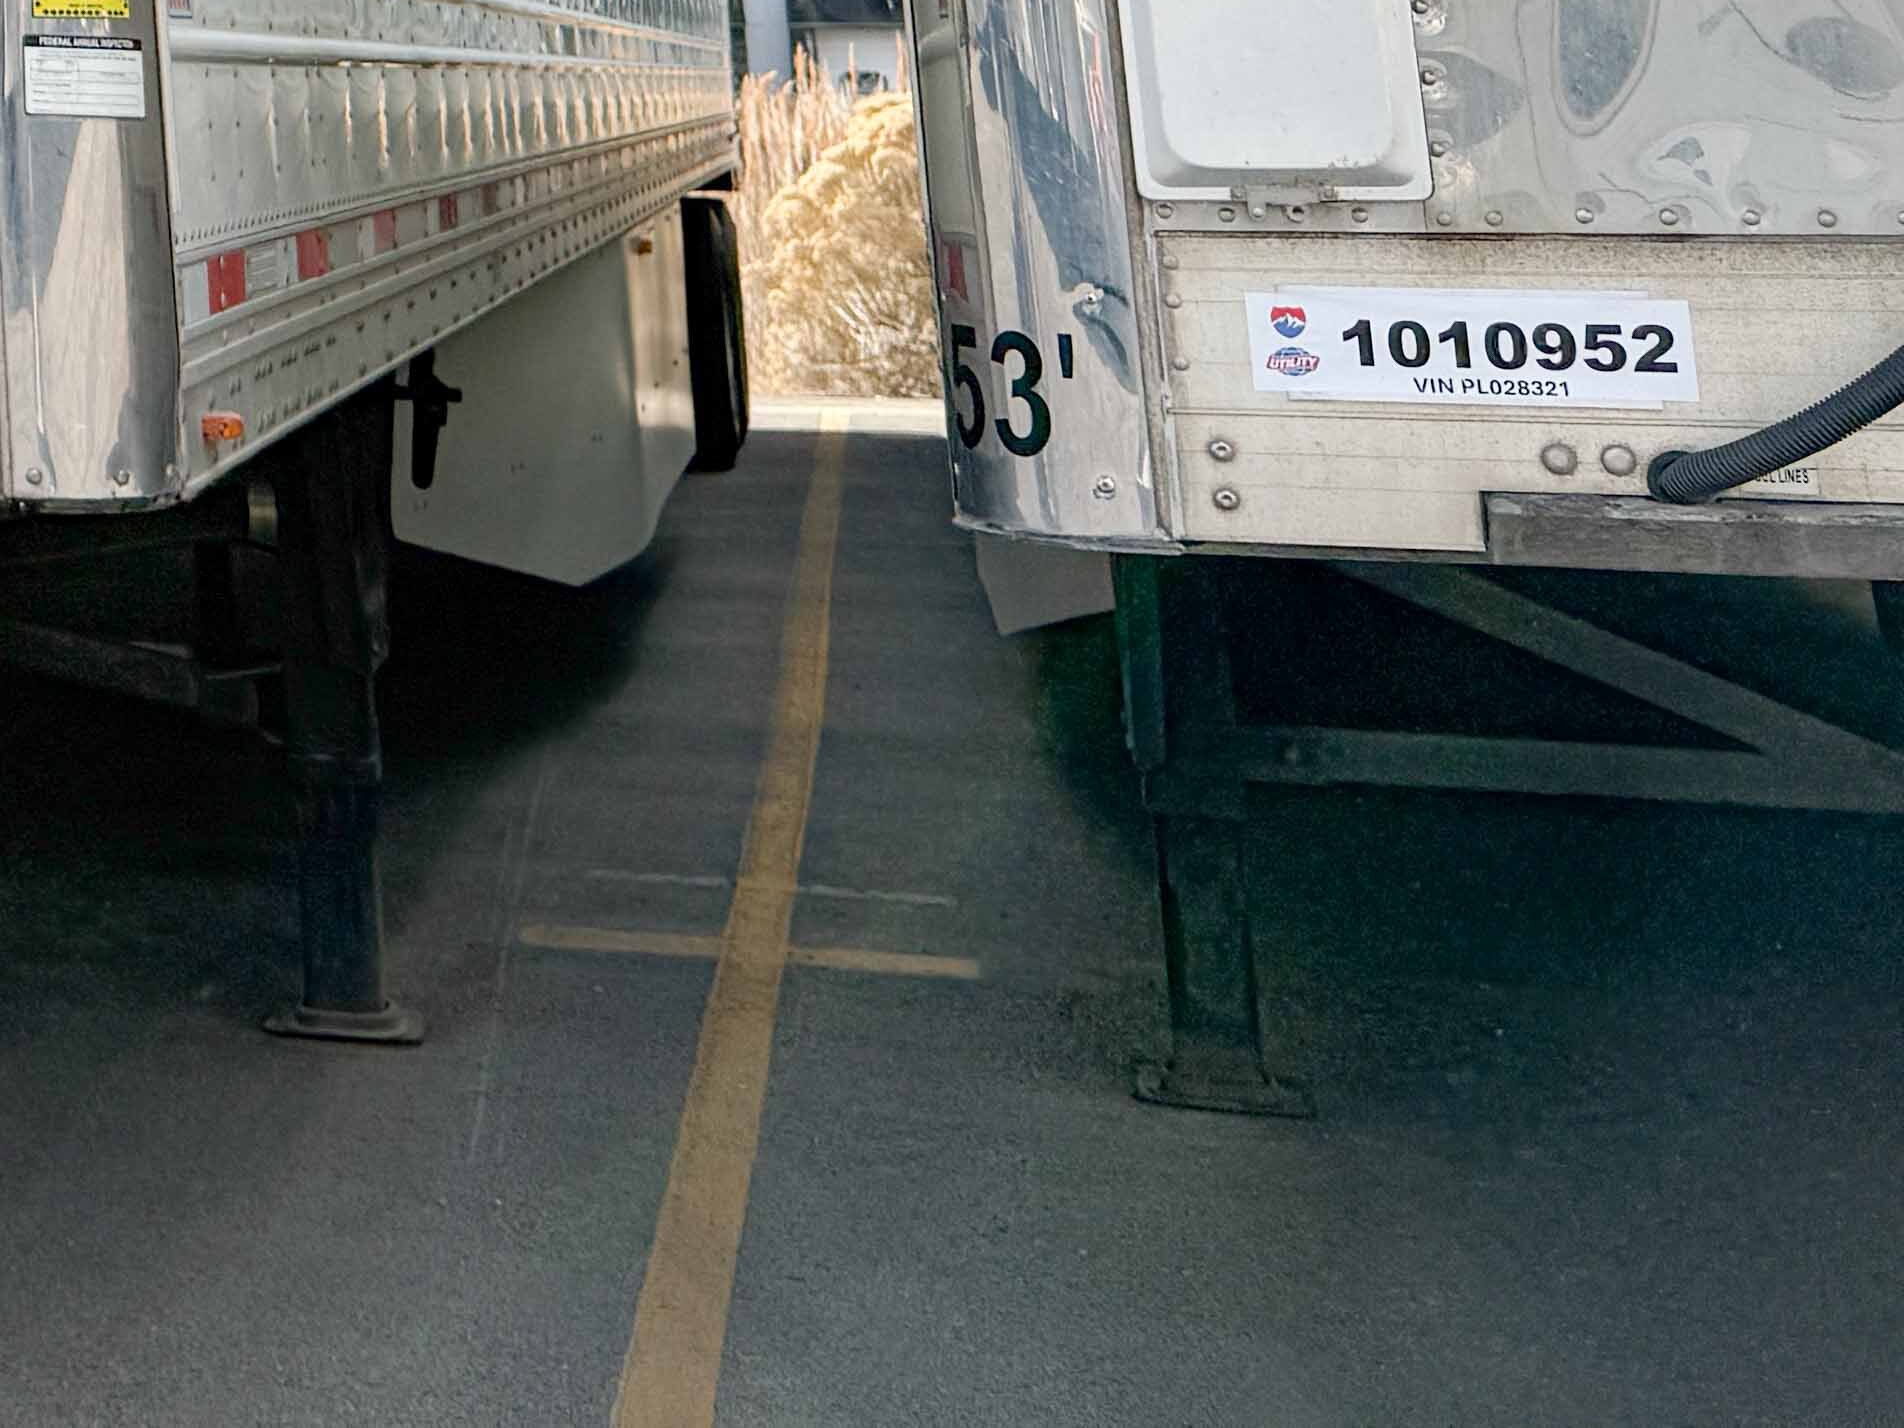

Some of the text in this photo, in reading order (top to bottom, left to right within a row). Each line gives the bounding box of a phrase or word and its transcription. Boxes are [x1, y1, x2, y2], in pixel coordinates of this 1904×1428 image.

[1341, 318, 1679, 375] 1010952
[950, 323, 1074, 458] 53'
[1414, 376, 1570, 398] VIN PL028321
[1778, 469, 1809, 484] LINES
